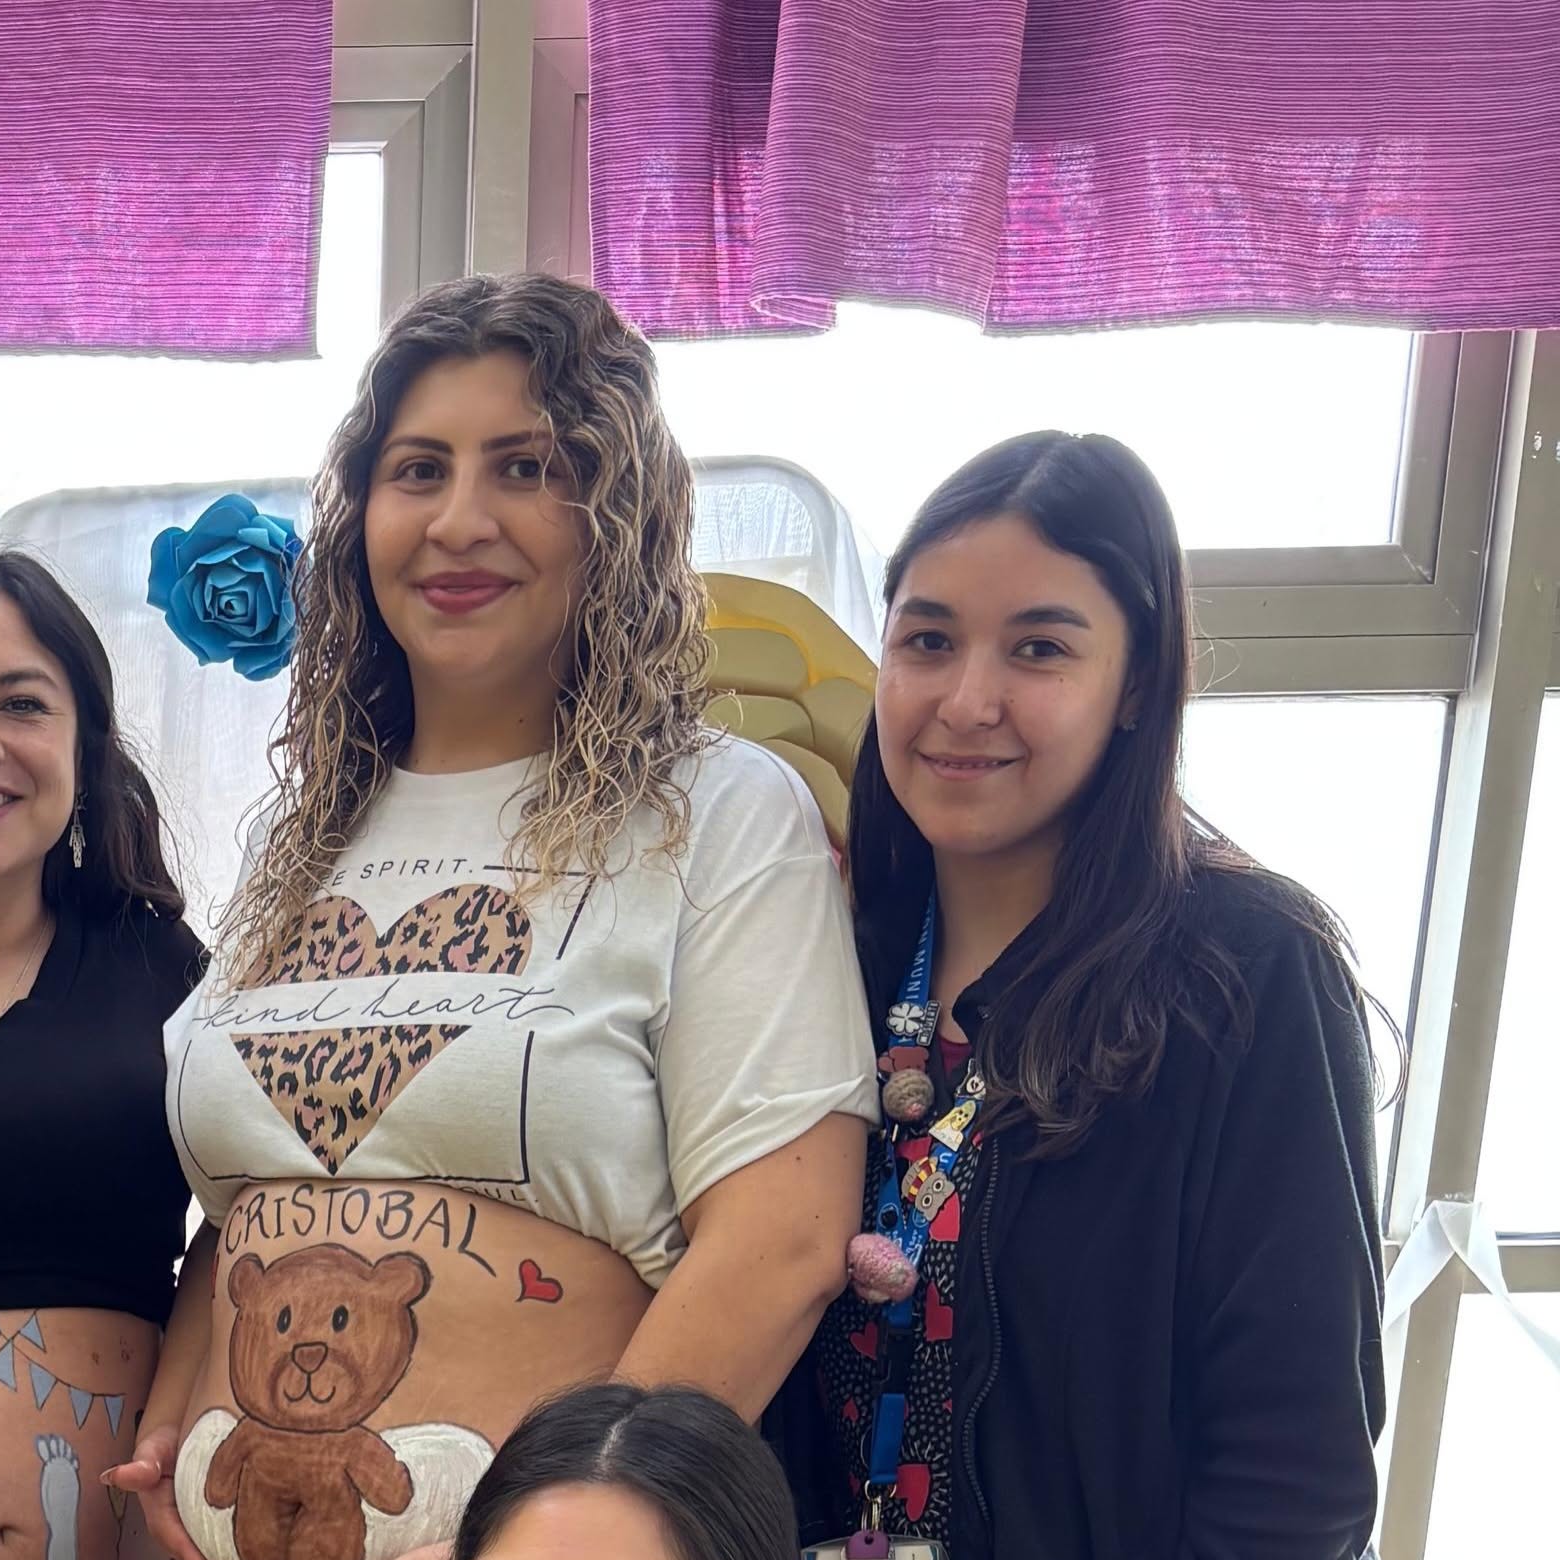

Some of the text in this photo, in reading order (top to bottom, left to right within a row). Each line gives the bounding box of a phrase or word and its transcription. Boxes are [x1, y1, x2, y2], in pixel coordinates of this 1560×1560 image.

[359, 858, 473, 880] SPIRIT.
[360, 978, 576, 1021] heart
[223, 1182, 498, 1278] CRISTOBAL
